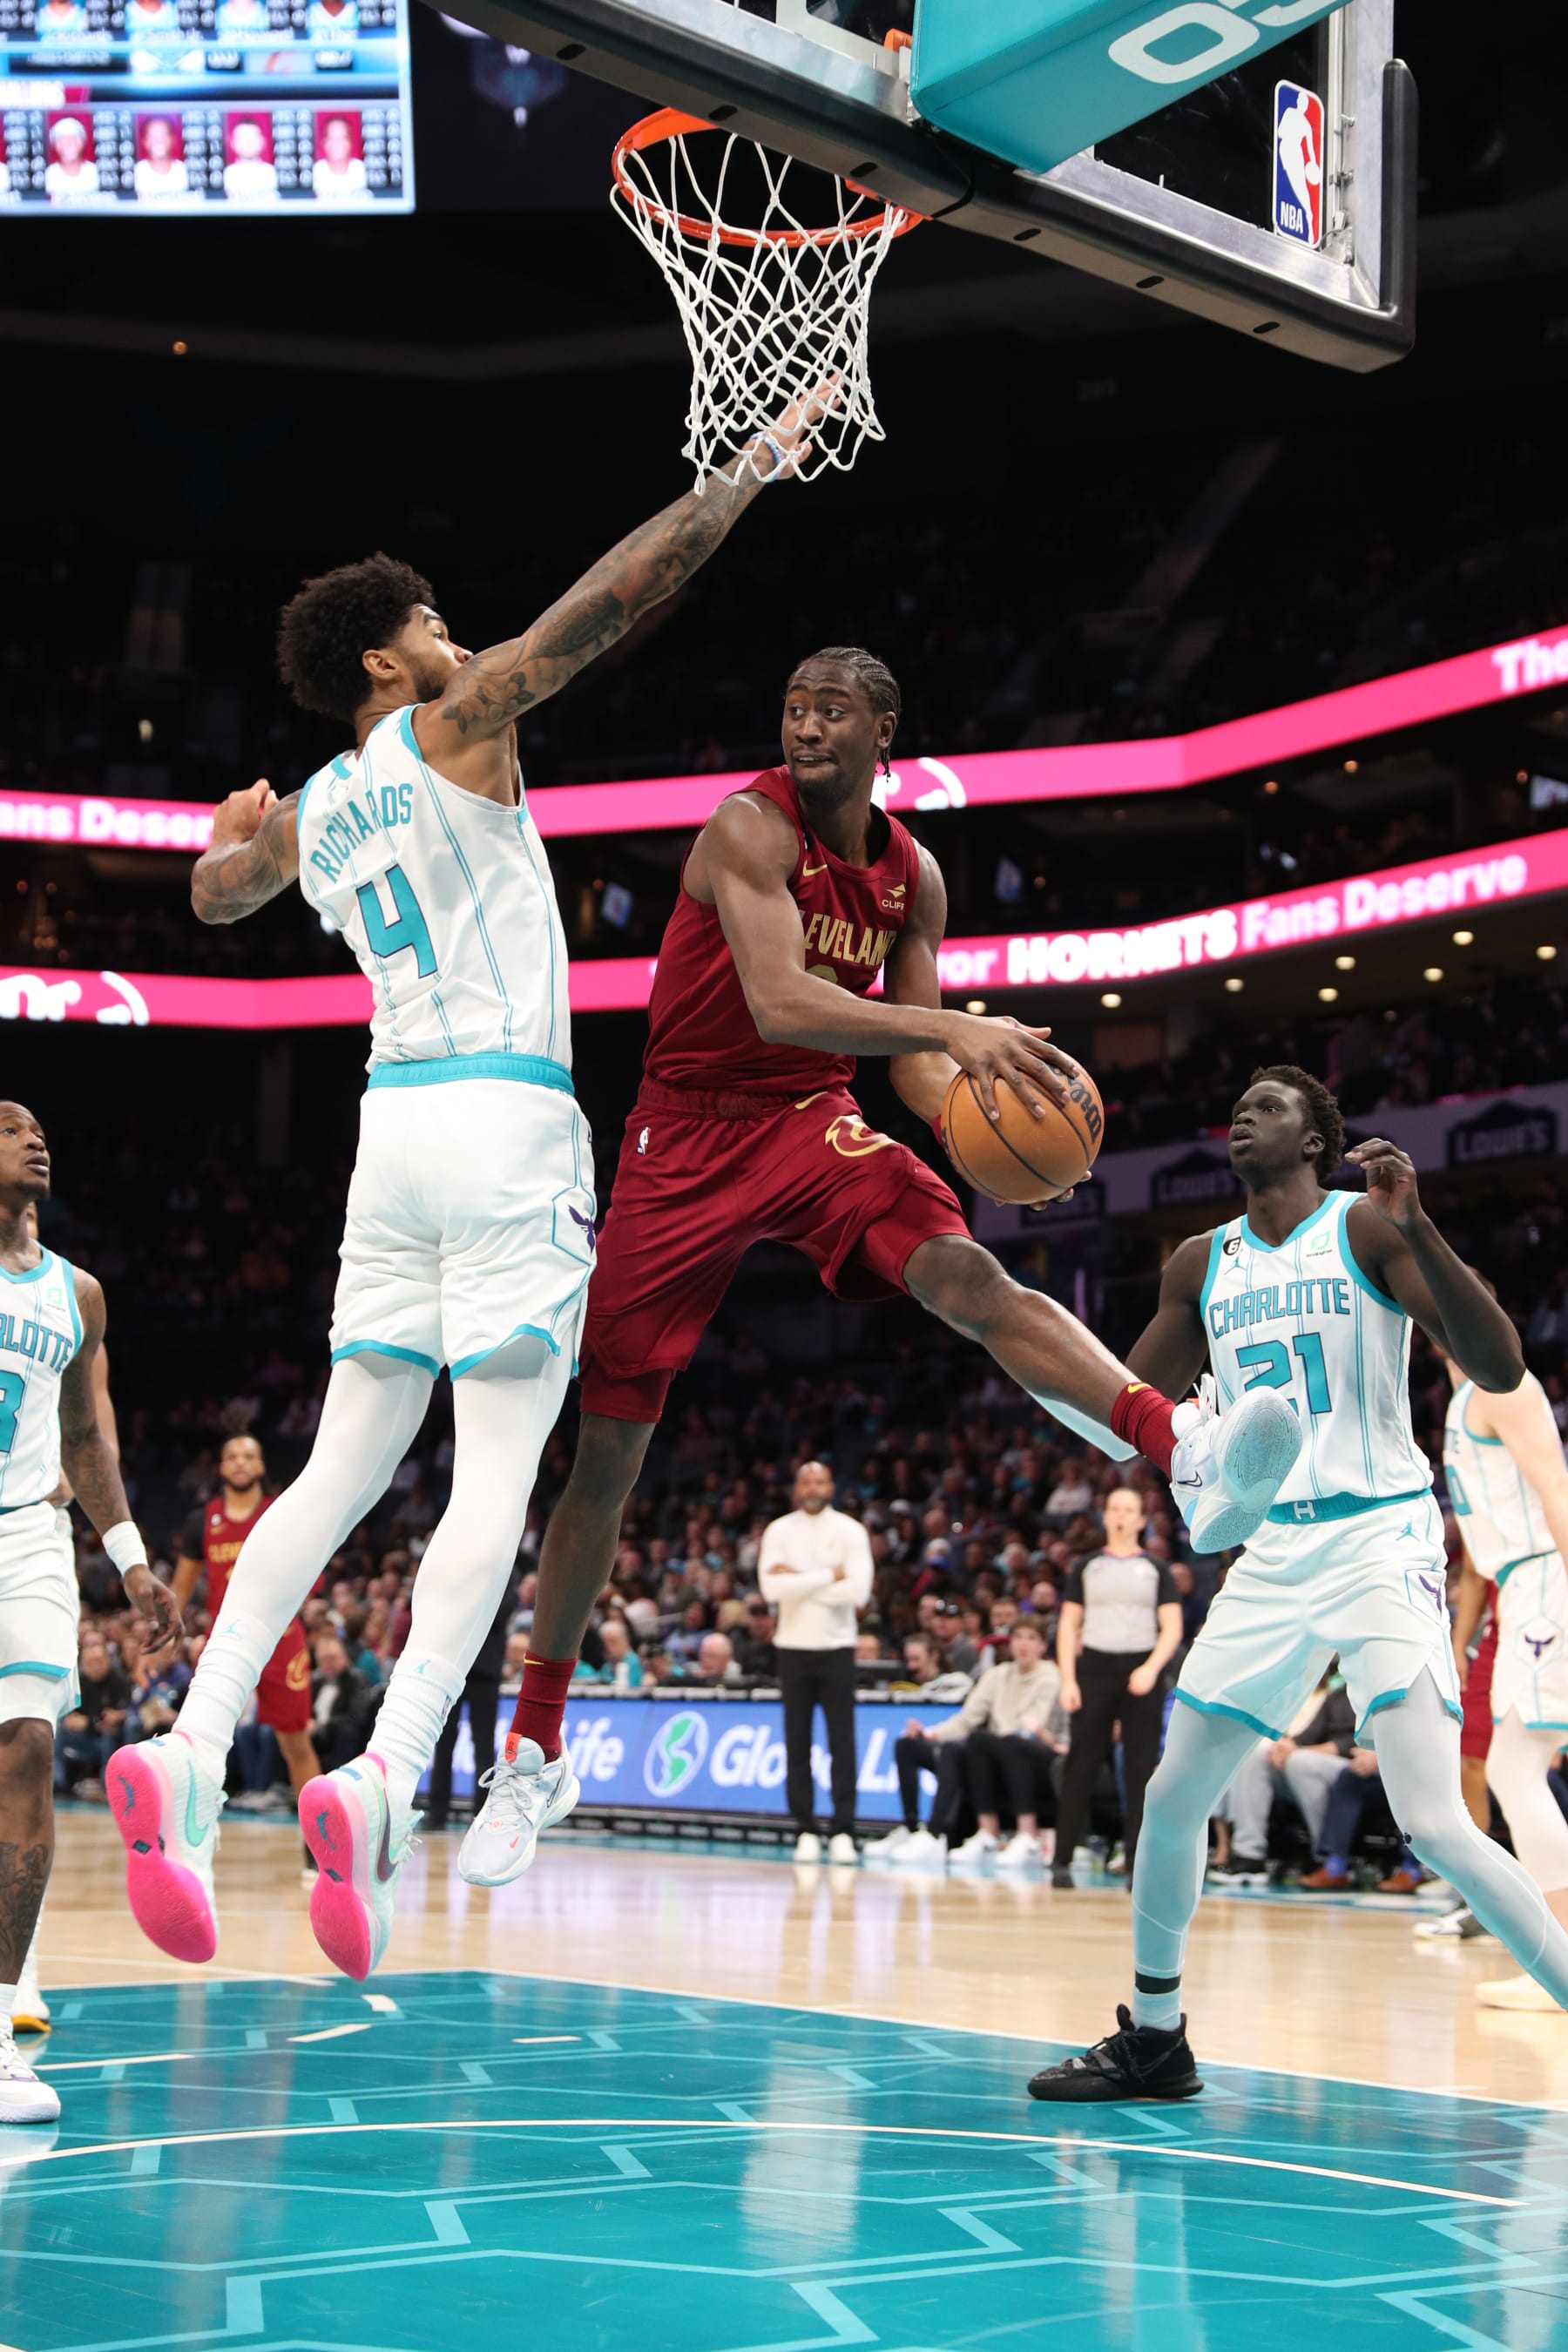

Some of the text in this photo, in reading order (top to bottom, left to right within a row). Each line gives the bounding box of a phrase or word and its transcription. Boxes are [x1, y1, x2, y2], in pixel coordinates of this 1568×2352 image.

[1281, 200, 1303, 234] NBA
[310, 783, 413, 883] RICHARDS
[356, 864, 438, 979] 4
[1008, 909, 1237, 983] HORNETS
[1242, 896, 1339, 949] Fans
[1343, 855, 1527, 929] Deserve
[1209, 1278, 1350, 1340] CHARLOTTE
[1235, 1332, 1332, 1416] 21
